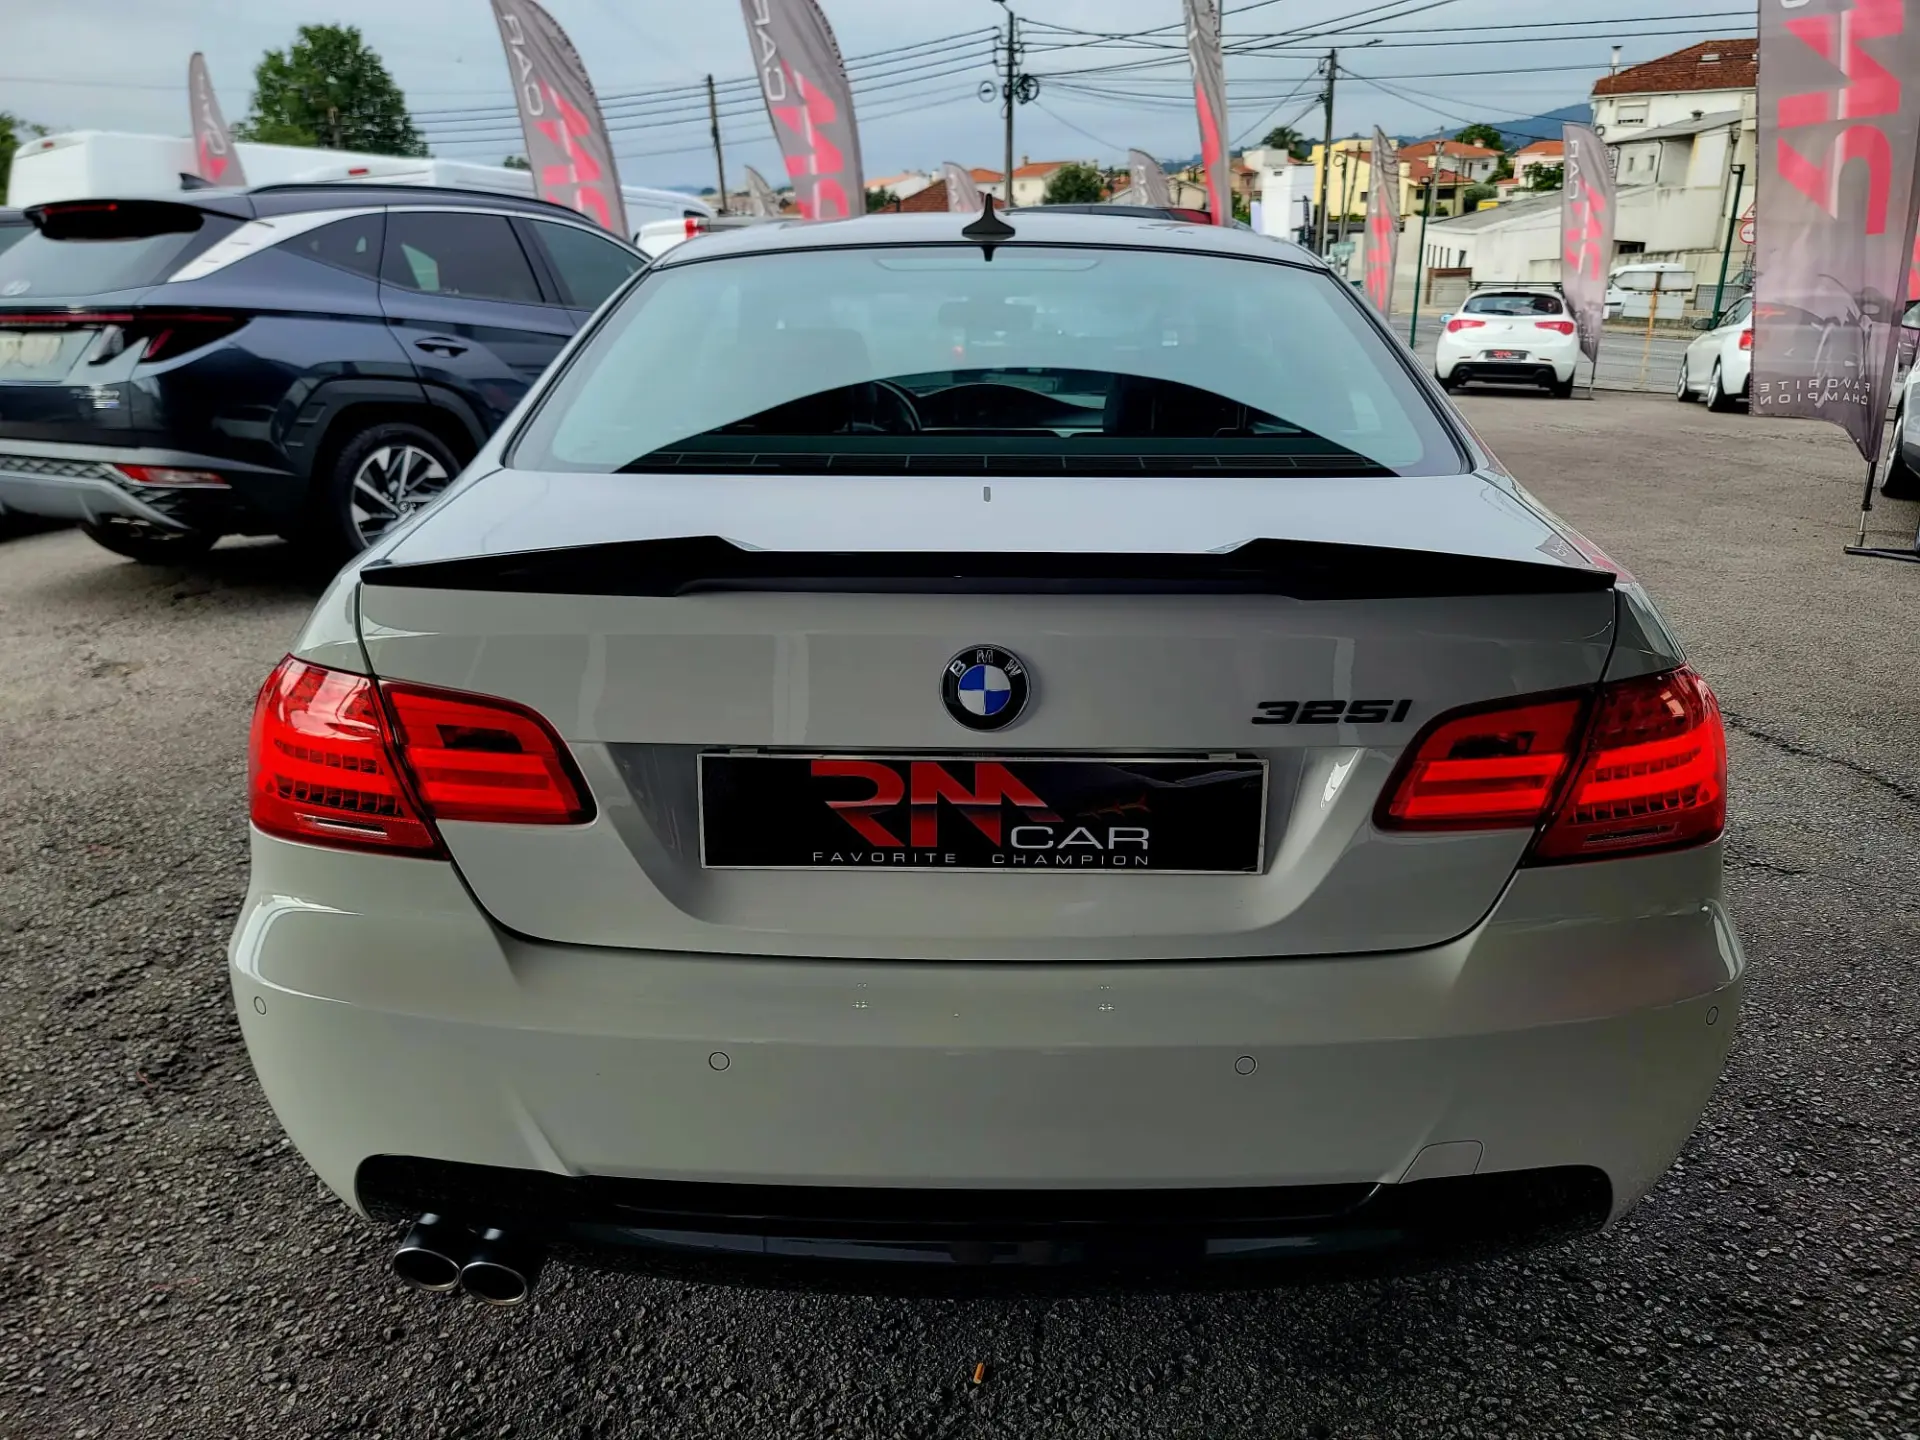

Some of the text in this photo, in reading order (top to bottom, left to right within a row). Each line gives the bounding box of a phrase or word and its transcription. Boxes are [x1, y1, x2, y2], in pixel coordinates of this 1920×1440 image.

[949, 649, 1022, 678] BMW
[811, 760, 1150, 850] RM CAR
[813, 851, 1149, 866] FAVORITE CHAMPION
